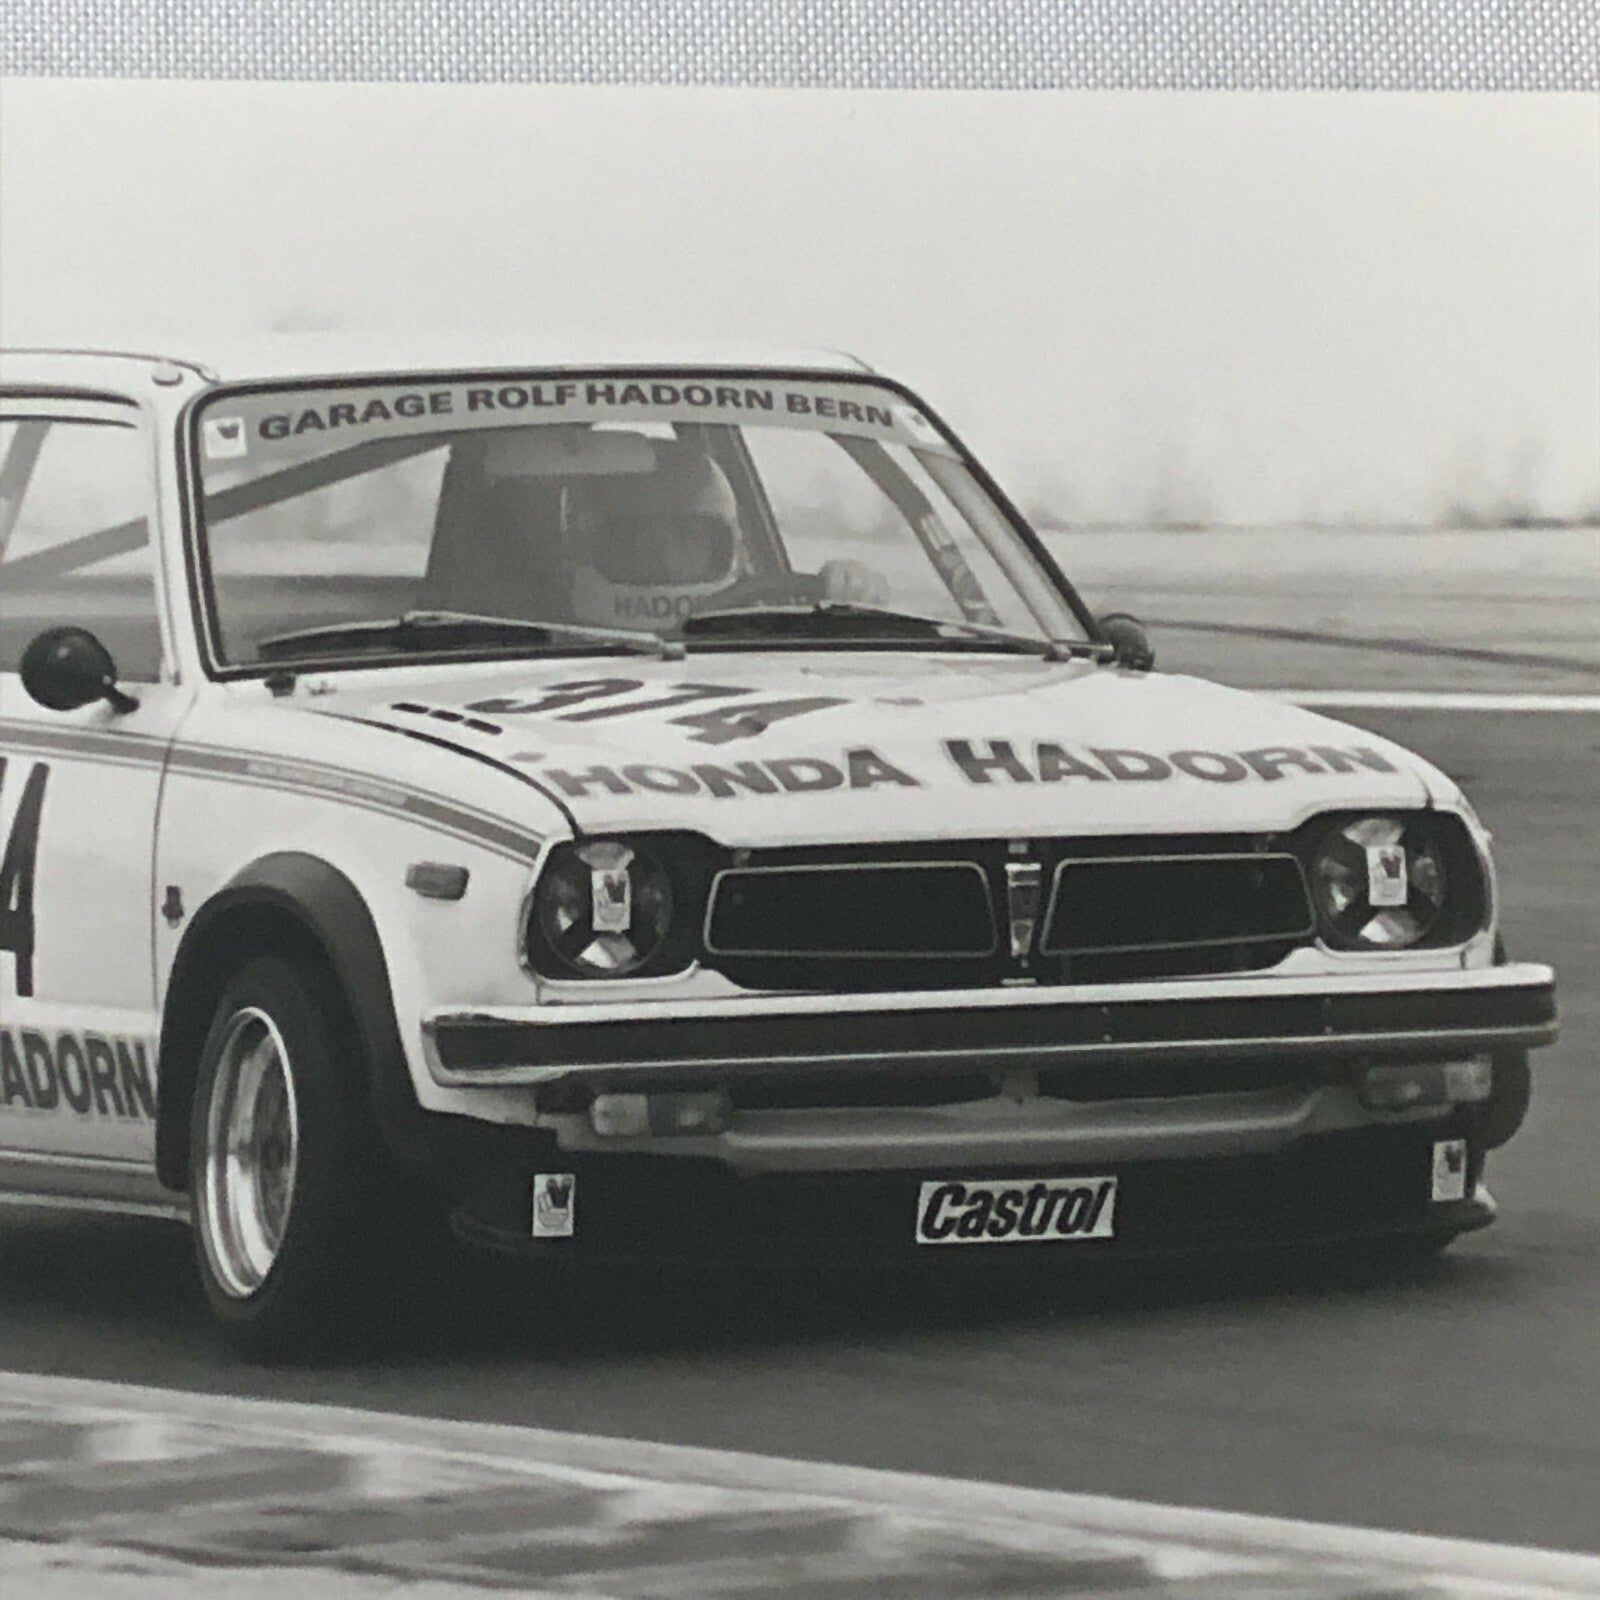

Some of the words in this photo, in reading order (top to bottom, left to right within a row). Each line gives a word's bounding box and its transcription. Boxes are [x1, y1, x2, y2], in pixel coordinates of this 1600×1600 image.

[258, 391, 453, 440] GARAGE
[466, 384, 577, 412] ROLF
[585, 384, 774, 411] HADORN
[785, 392, 894, 427] BERN
[542, 749, 921, 798] HONDA
[944, 740, 1397, 784] HADORN
[921, 1181, 1113, 1239] Castrol
